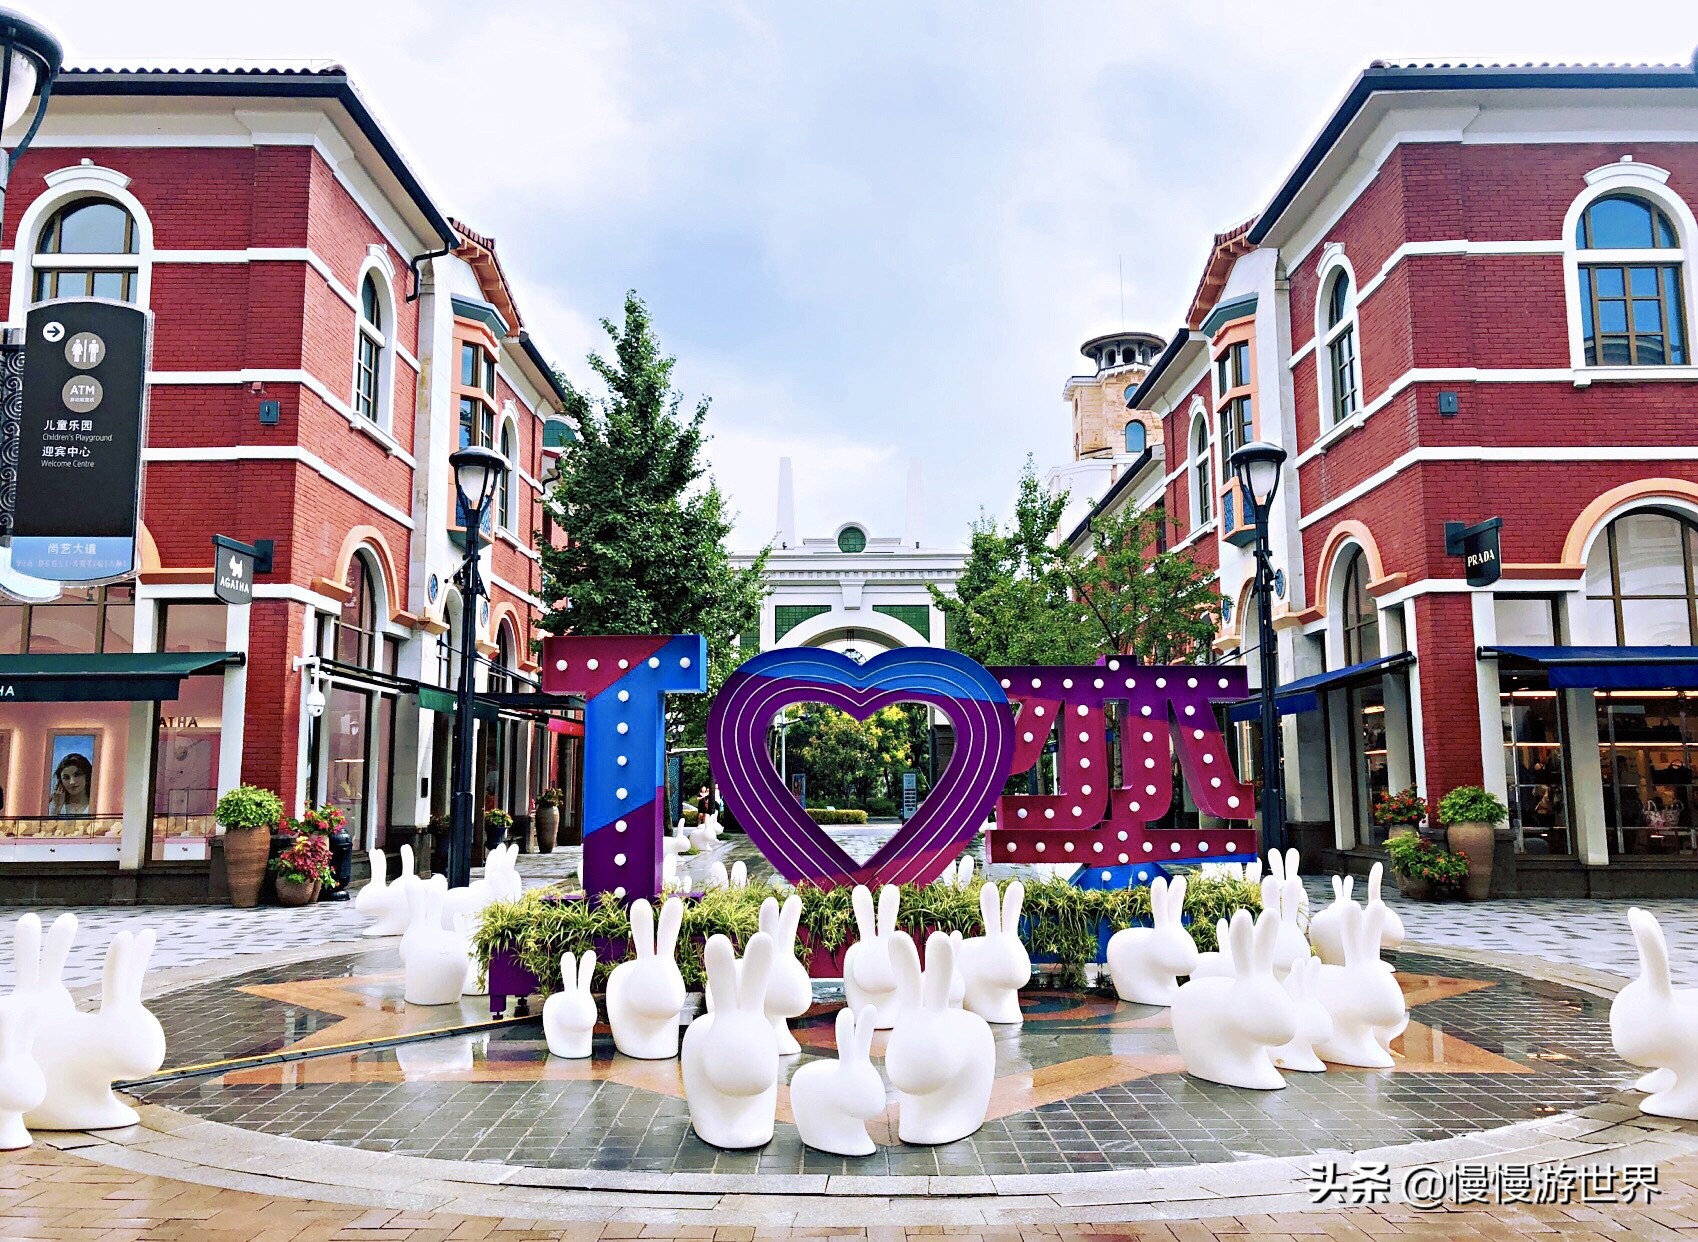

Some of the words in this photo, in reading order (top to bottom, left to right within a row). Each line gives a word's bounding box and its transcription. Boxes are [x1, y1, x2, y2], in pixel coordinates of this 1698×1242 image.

[69, 384, 95, 395] ATM
[43, 419, 93, 431] 儿童乐园
[42, 433, 74, 441] Children's
[75, 433, 112, 442] Playground
[41, 445, 91, 457] 迎宾中心
[72, 459, 95, 468] Centre
[47, 542, 97, 555] 尚艺大道
[1467, 549, 1495, 567] PRADA
[219, 575, 250, 594] AGATHA
